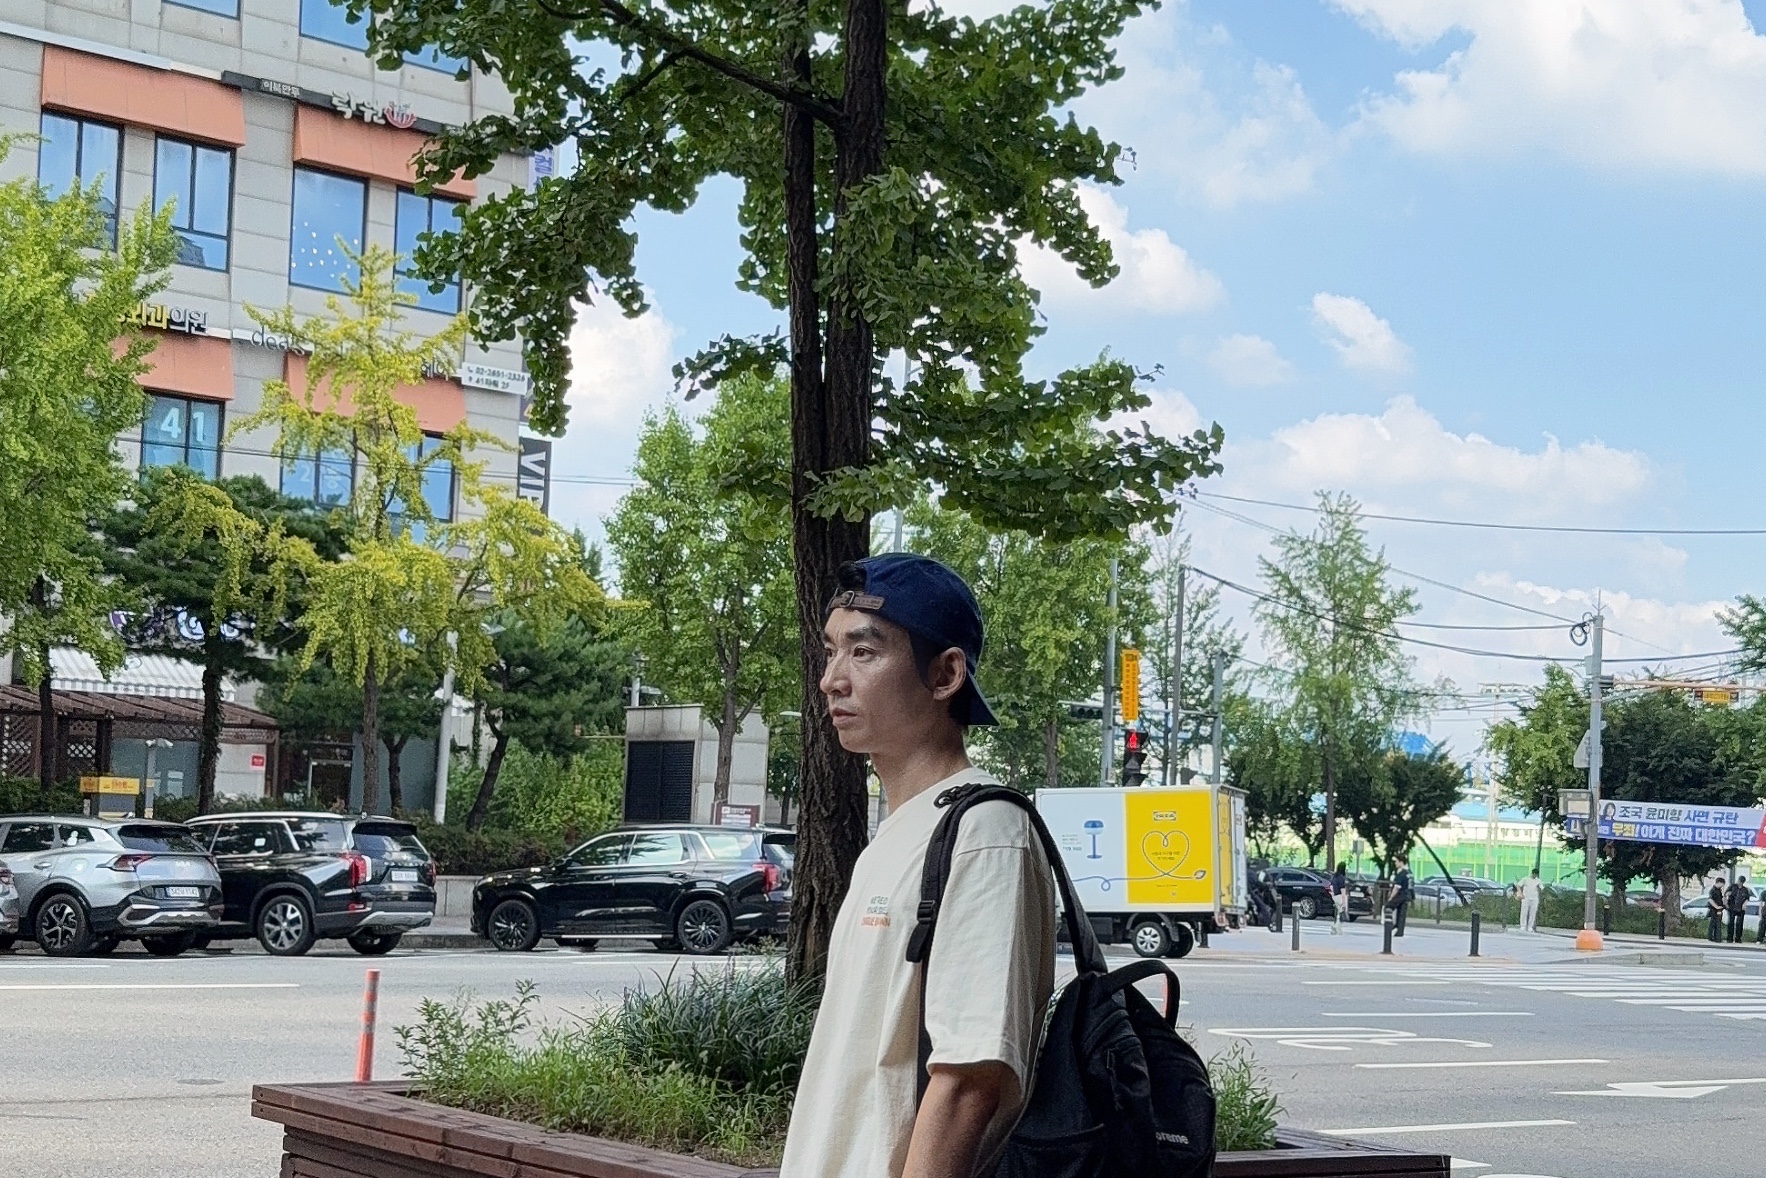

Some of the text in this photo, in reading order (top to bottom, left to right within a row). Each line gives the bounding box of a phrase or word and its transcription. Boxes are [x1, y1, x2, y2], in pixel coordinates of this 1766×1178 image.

[1619, 806, 1739, 825] 조국 윤미향 사면 규탄
[1641, 825, 1666, 839] 이게
[1668, 827, 1692, 842] 진짜
[1695, 829, 1756, 845] 대한민국?
